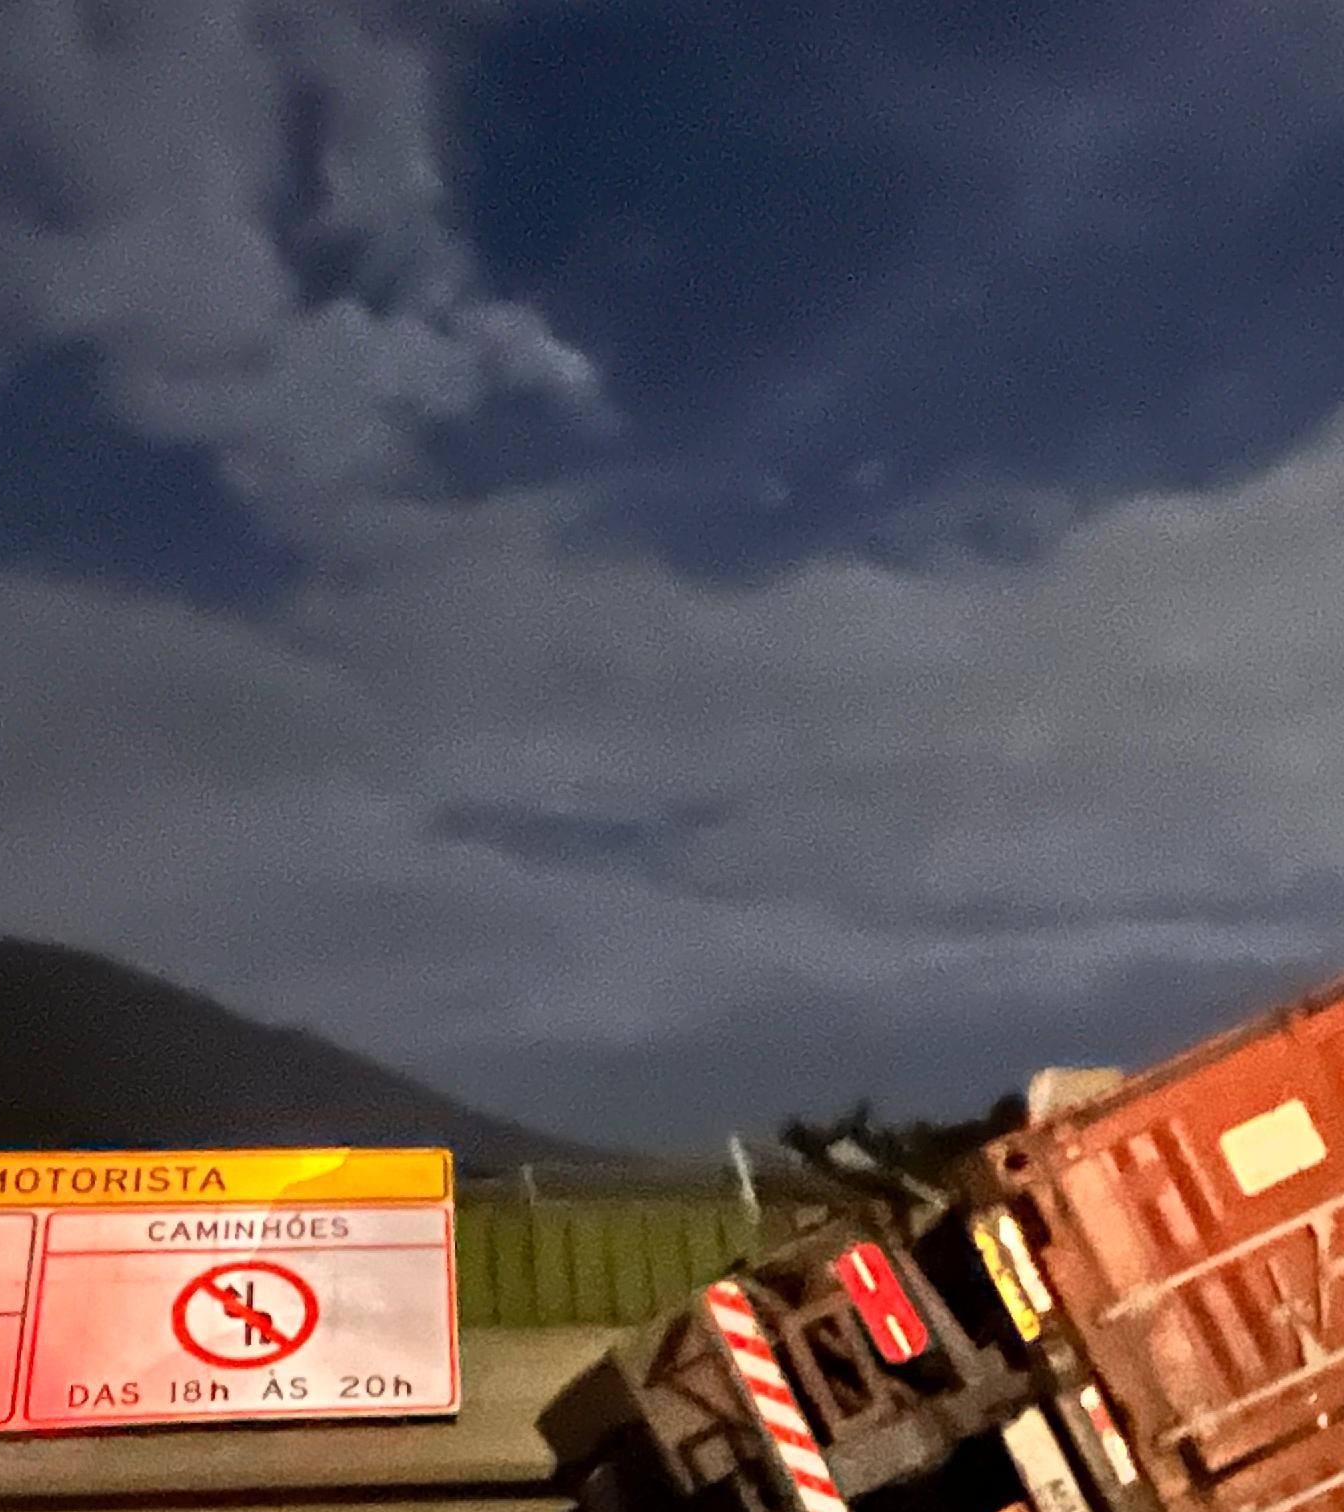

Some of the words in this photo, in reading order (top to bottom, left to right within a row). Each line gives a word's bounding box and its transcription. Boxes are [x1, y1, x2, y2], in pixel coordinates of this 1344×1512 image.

[147, 1214, 351, 1242] CAMINHÕES
[67, 1382, 142, 1409] DAS
[169, 1379, 230, 1403] 18h
[339, 1374, 414, 1399] 20h
